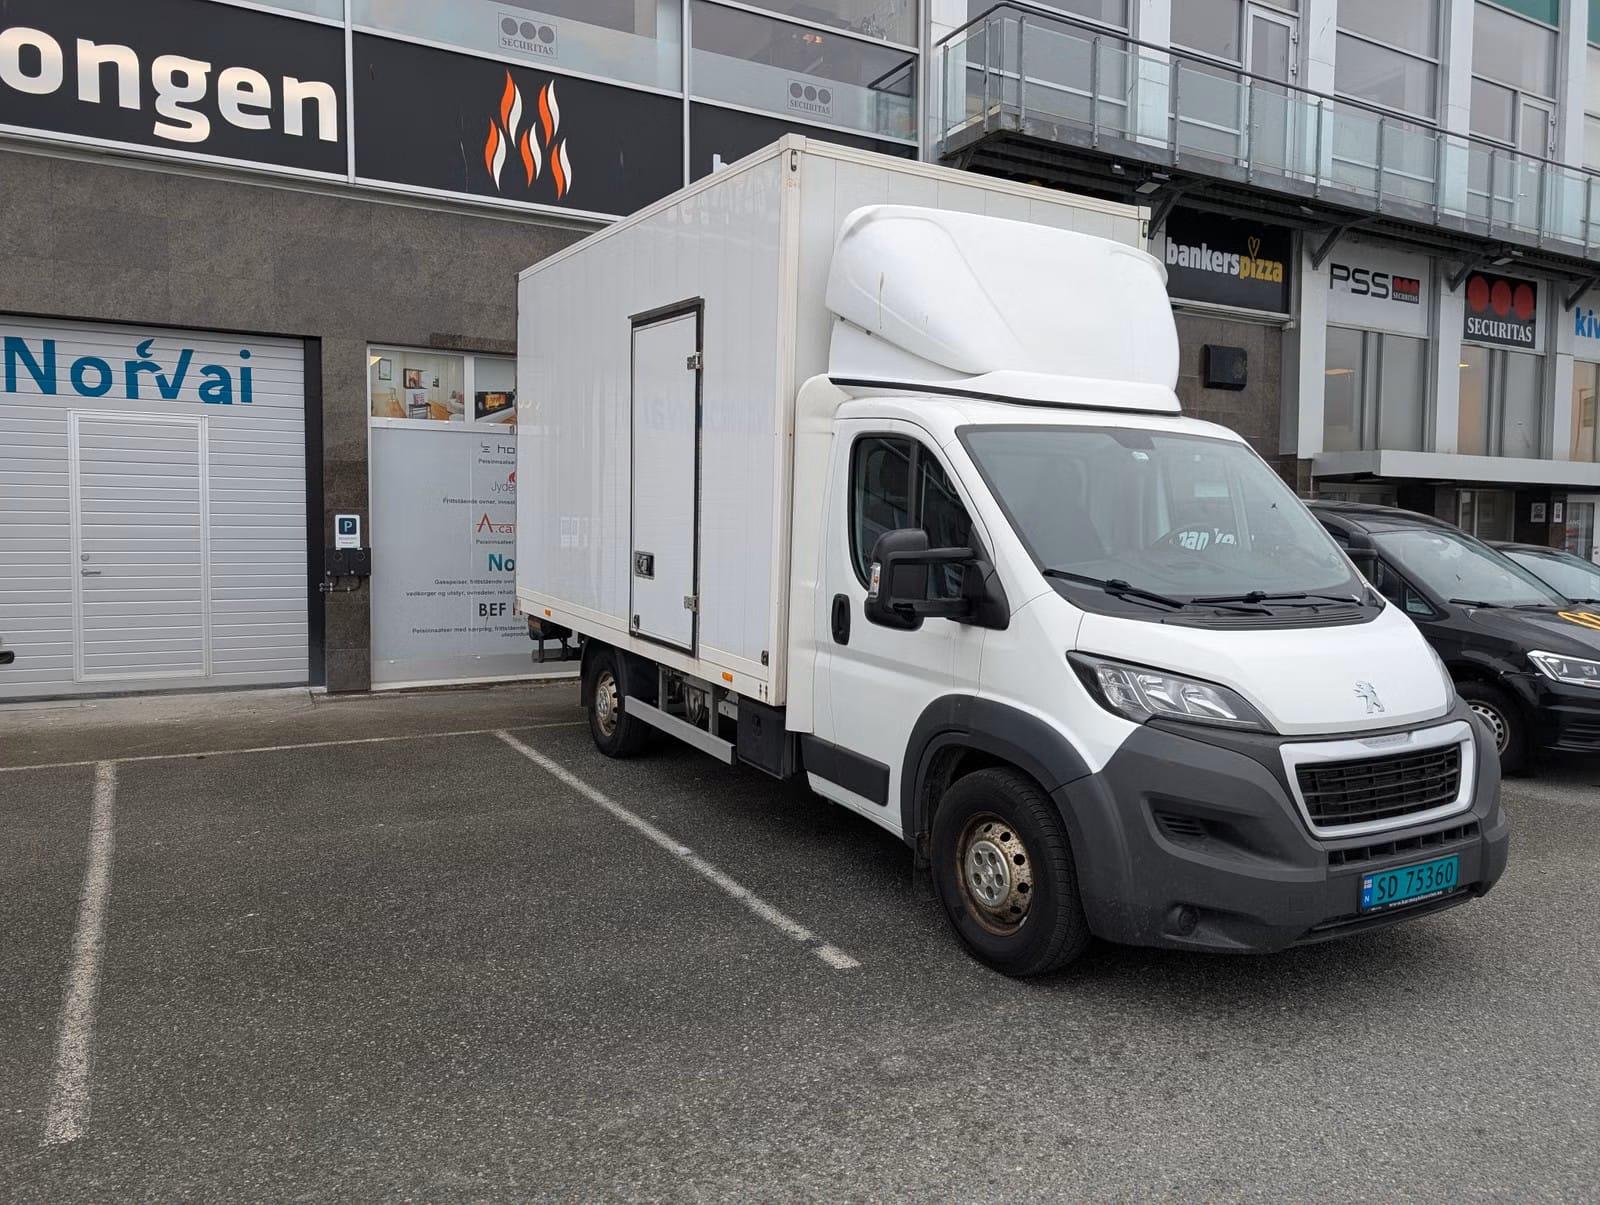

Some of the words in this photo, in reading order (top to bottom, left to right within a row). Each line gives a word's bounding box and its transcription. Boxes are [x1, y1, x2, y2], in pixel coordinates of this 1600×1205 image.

[502, 37, 554, 55] SECURITAS
[0, 27, 338, 142] ongen
[790, 99, 830, 113] SECURITAS
[1330, 263, 1389, 299] PSS
[1393, 291, 1418, 303] SECURITAS
[1467, 317, 1532, 342] SECURITAS
[344, 520, 352, 533] P
[488, 553, 515, 572] No
[479, 603, 507, 617] BEF
[1377, 875, 1398, 901] SD
[1406, 862, 1454, 894] 75360
[1364, 895, 1370, 904] N
